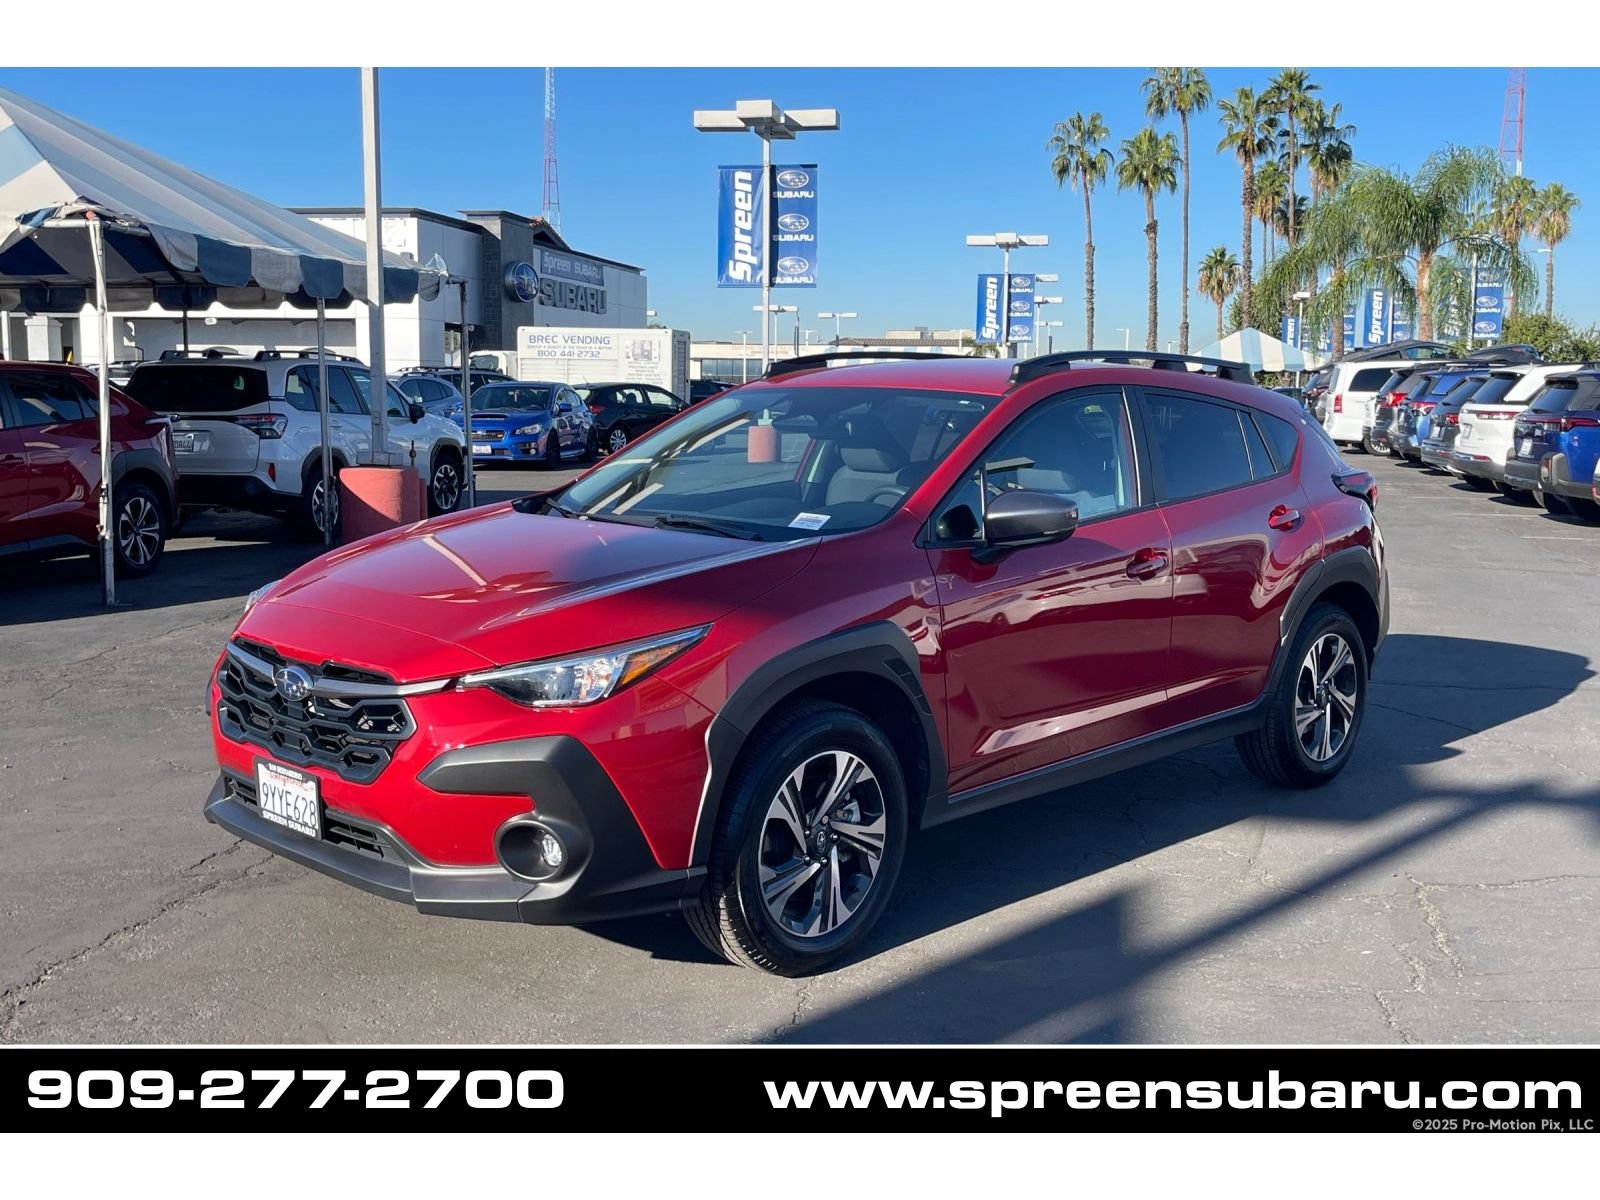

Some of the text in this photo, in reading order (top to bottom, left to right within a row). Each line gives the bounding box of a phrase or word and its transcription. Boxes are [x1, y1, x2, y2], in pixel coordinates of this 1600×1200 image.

[772, 190, 814, 198] SUBARU
[728, 171, 757, 282] Spreen
[772, 234, 814, 242] SUBARU
[543, 251, 602, 279] Spreen SUBARU
[772, 276, 814, 284] SUBARU
[538, 278, 608, 315] SUBARU
[982, 277, 1000, 340] Spreen
[1368, 291, 1384, 344] Spreen
[529, 334, 611, 345] BREC VENDING
[560, 350, 601, 358] 441-2732
[262, 782, 317, 828] 9YYE628
